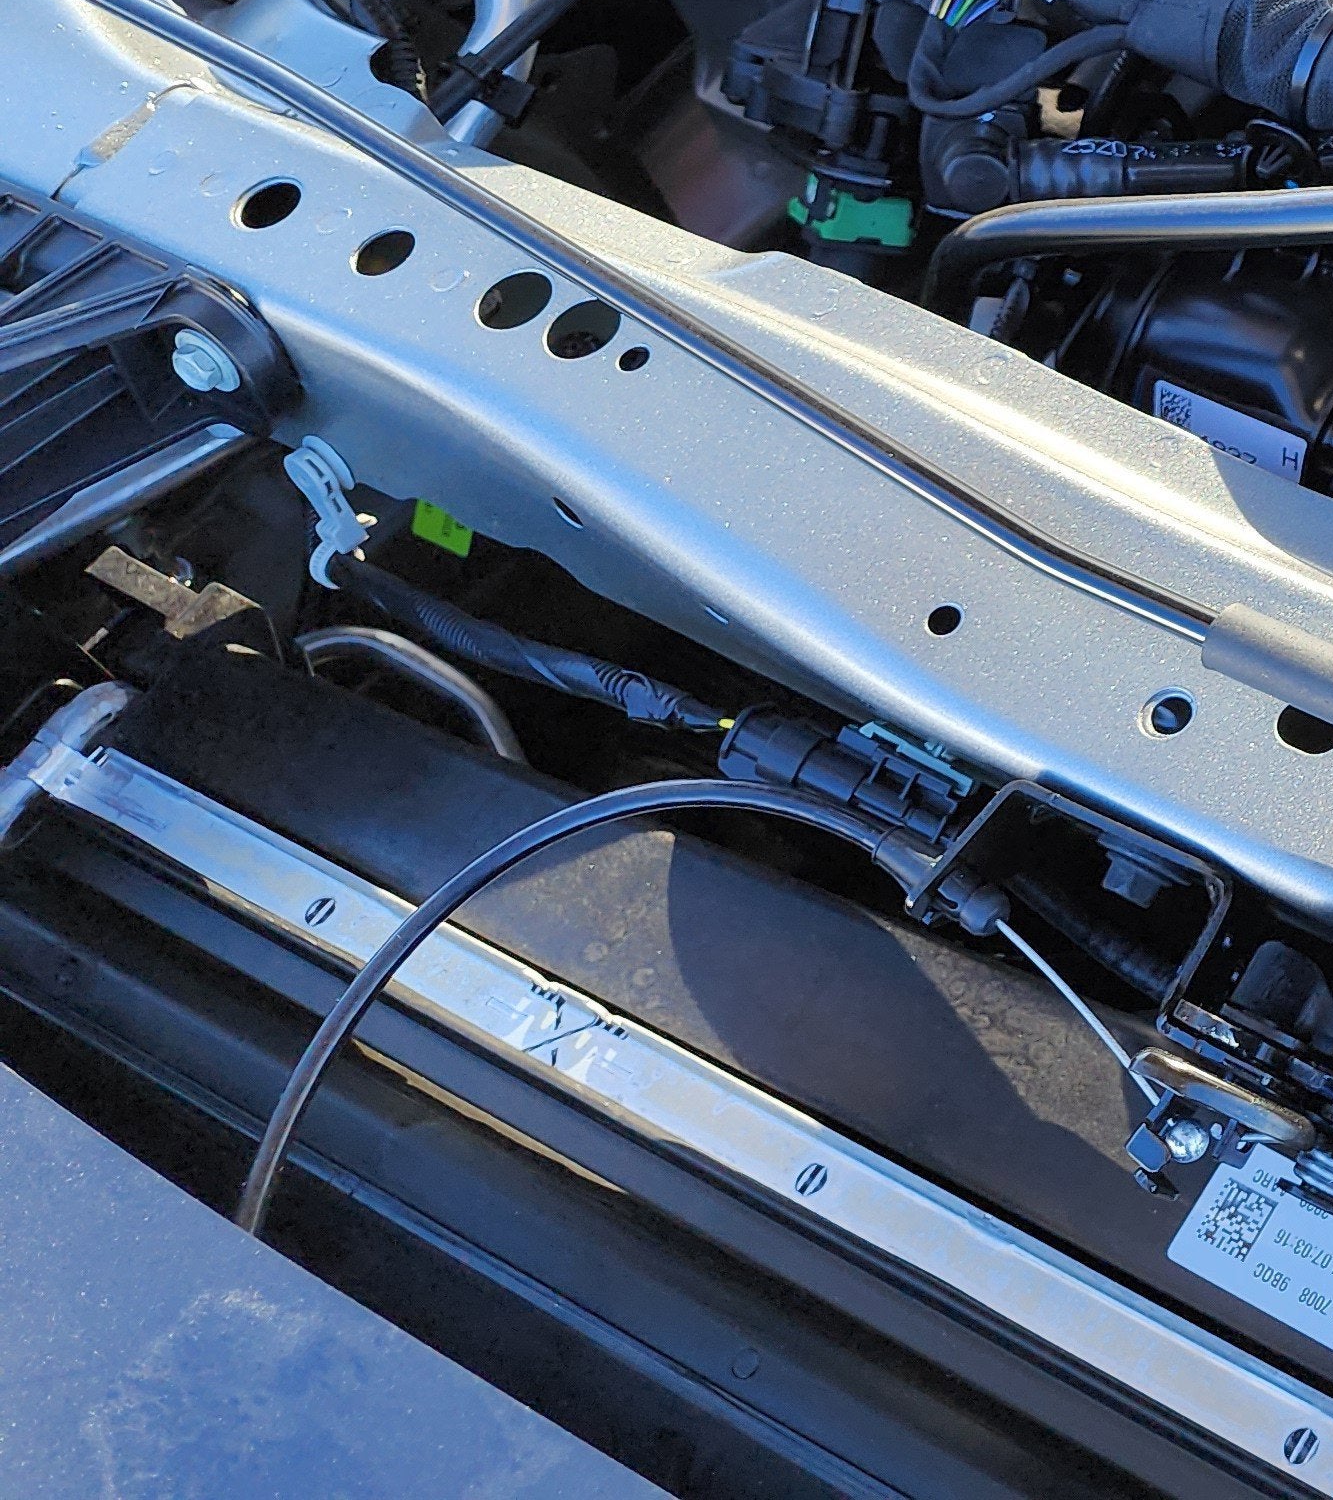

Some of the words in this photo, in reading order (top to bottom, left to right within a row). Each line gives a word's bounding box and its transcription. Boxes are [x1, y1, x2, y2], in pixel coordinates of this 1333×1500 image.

[1281, 445, 1299, 472] H
[1272, 1227, 1333, 1270] 07:03:16
[1252, 1261, 1292, 1293] 9BQC
[1297, 1286, 1333, 1317] 7008
